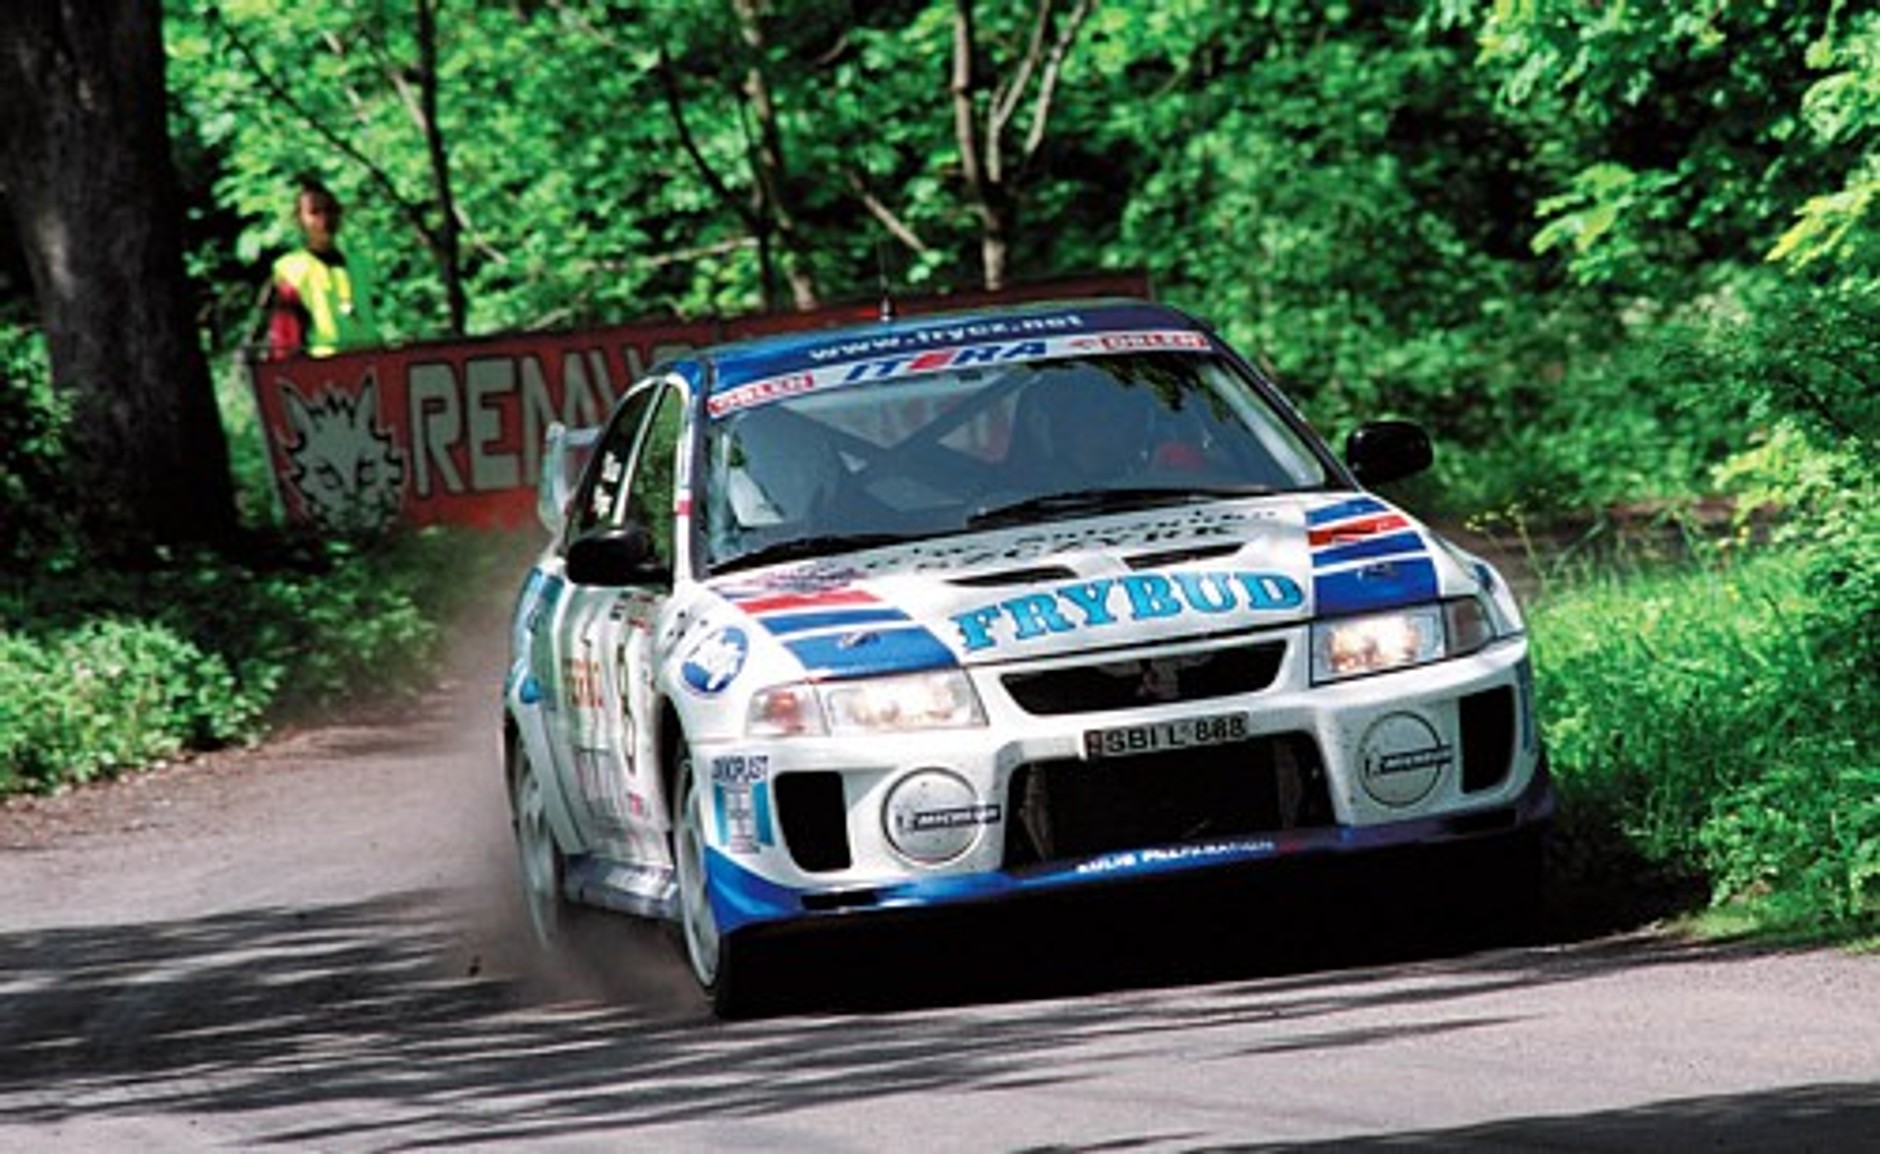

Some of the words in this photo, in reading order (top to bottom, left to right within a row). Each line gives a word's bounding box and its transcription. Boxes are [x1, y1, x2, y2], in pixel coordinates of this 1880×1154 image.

[846, 340, 1047, 381] ITERA
[408, 343, 693, 496] REM
[950, 569, 1305, 653] FRYBUD
